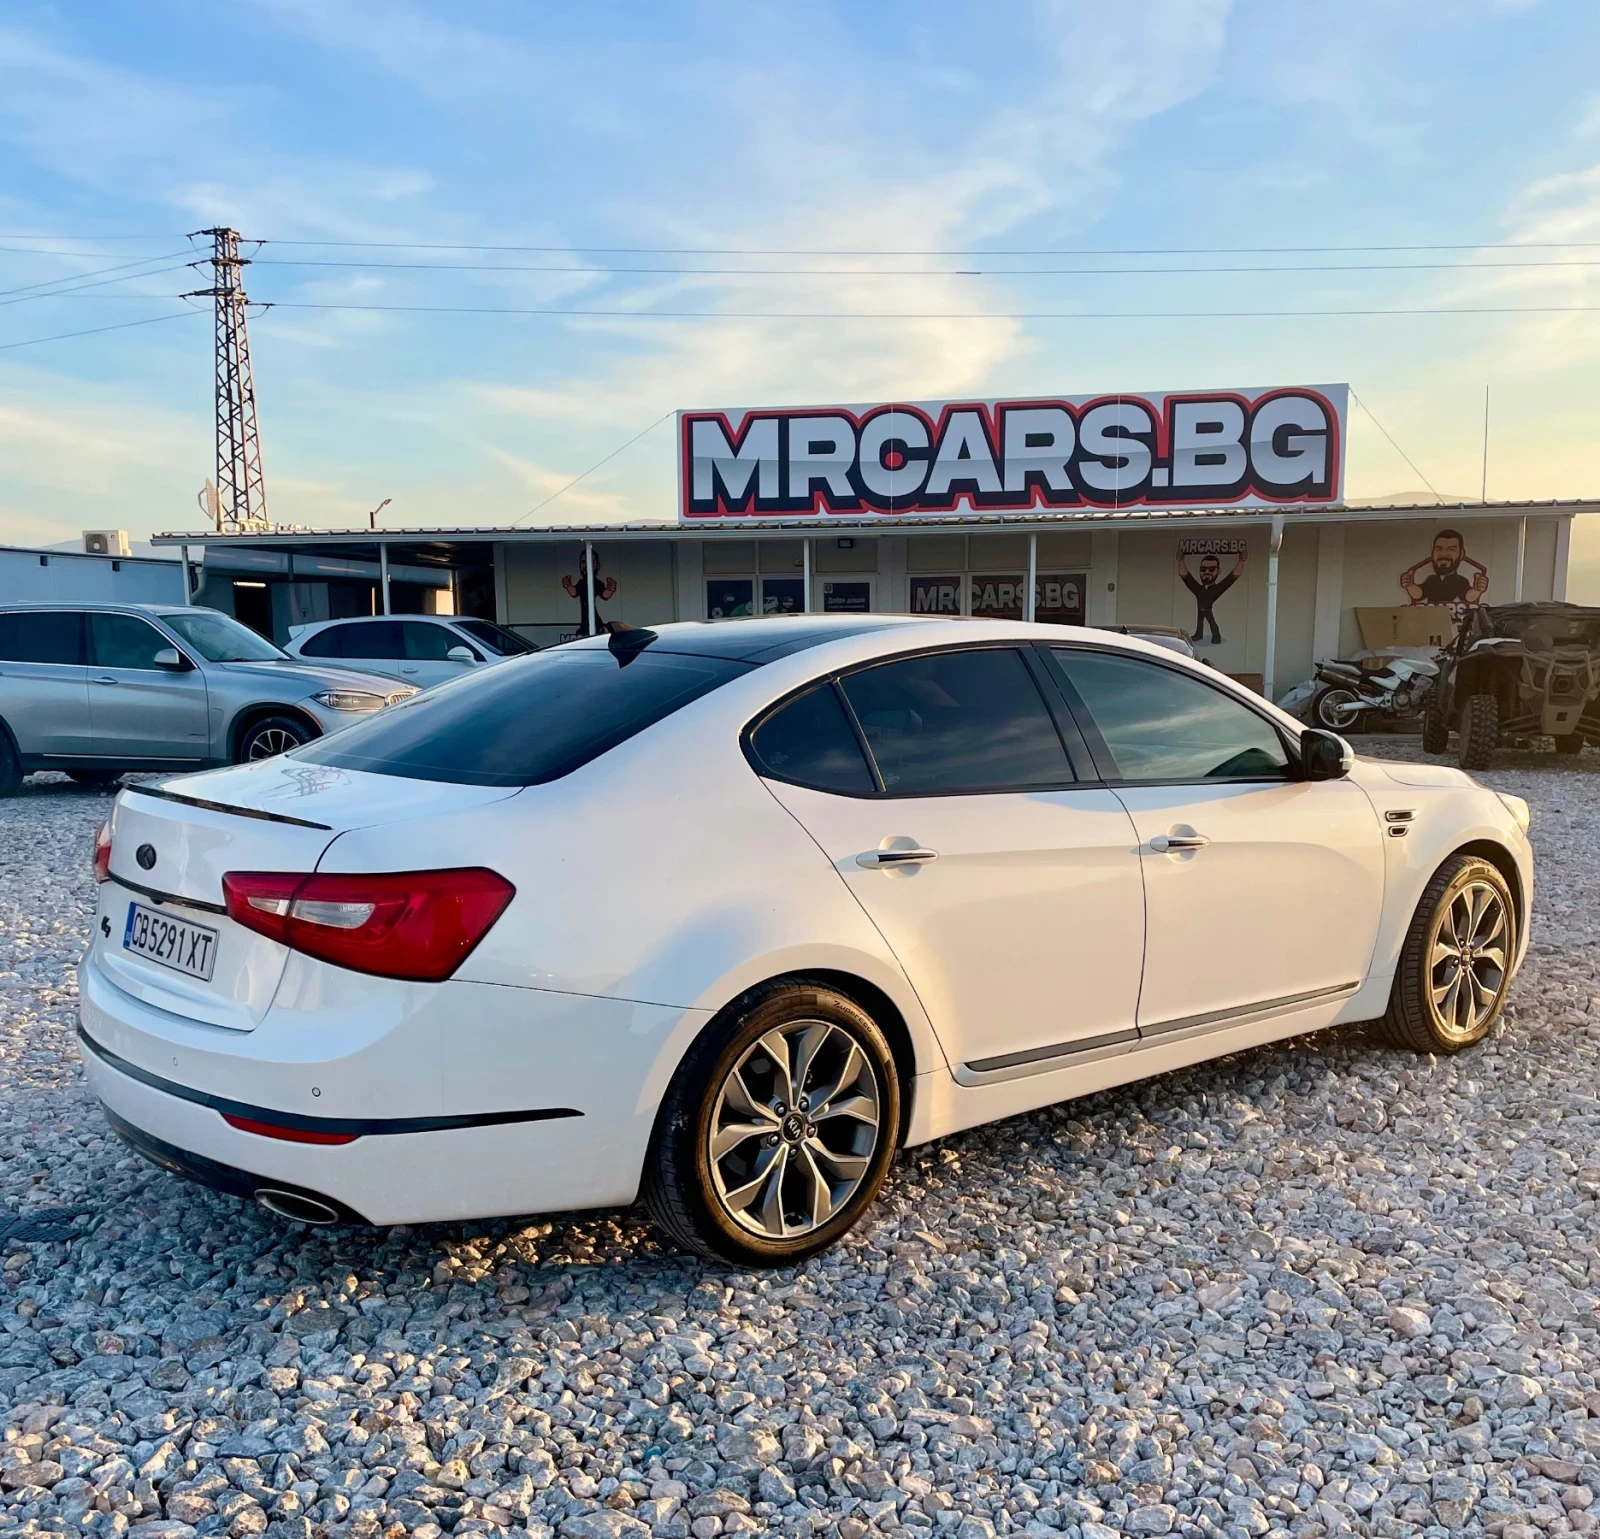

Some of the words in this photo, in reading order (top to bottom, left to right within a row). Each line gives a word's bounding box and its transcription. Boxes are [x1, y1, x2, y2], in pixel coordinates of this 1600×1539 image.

[690, 394, 1330, 502] MRCARS.BG
[1179, 539, 1246, 554] MRCARS.BG
[833, 1000, 872, 1033] ZuperEco
